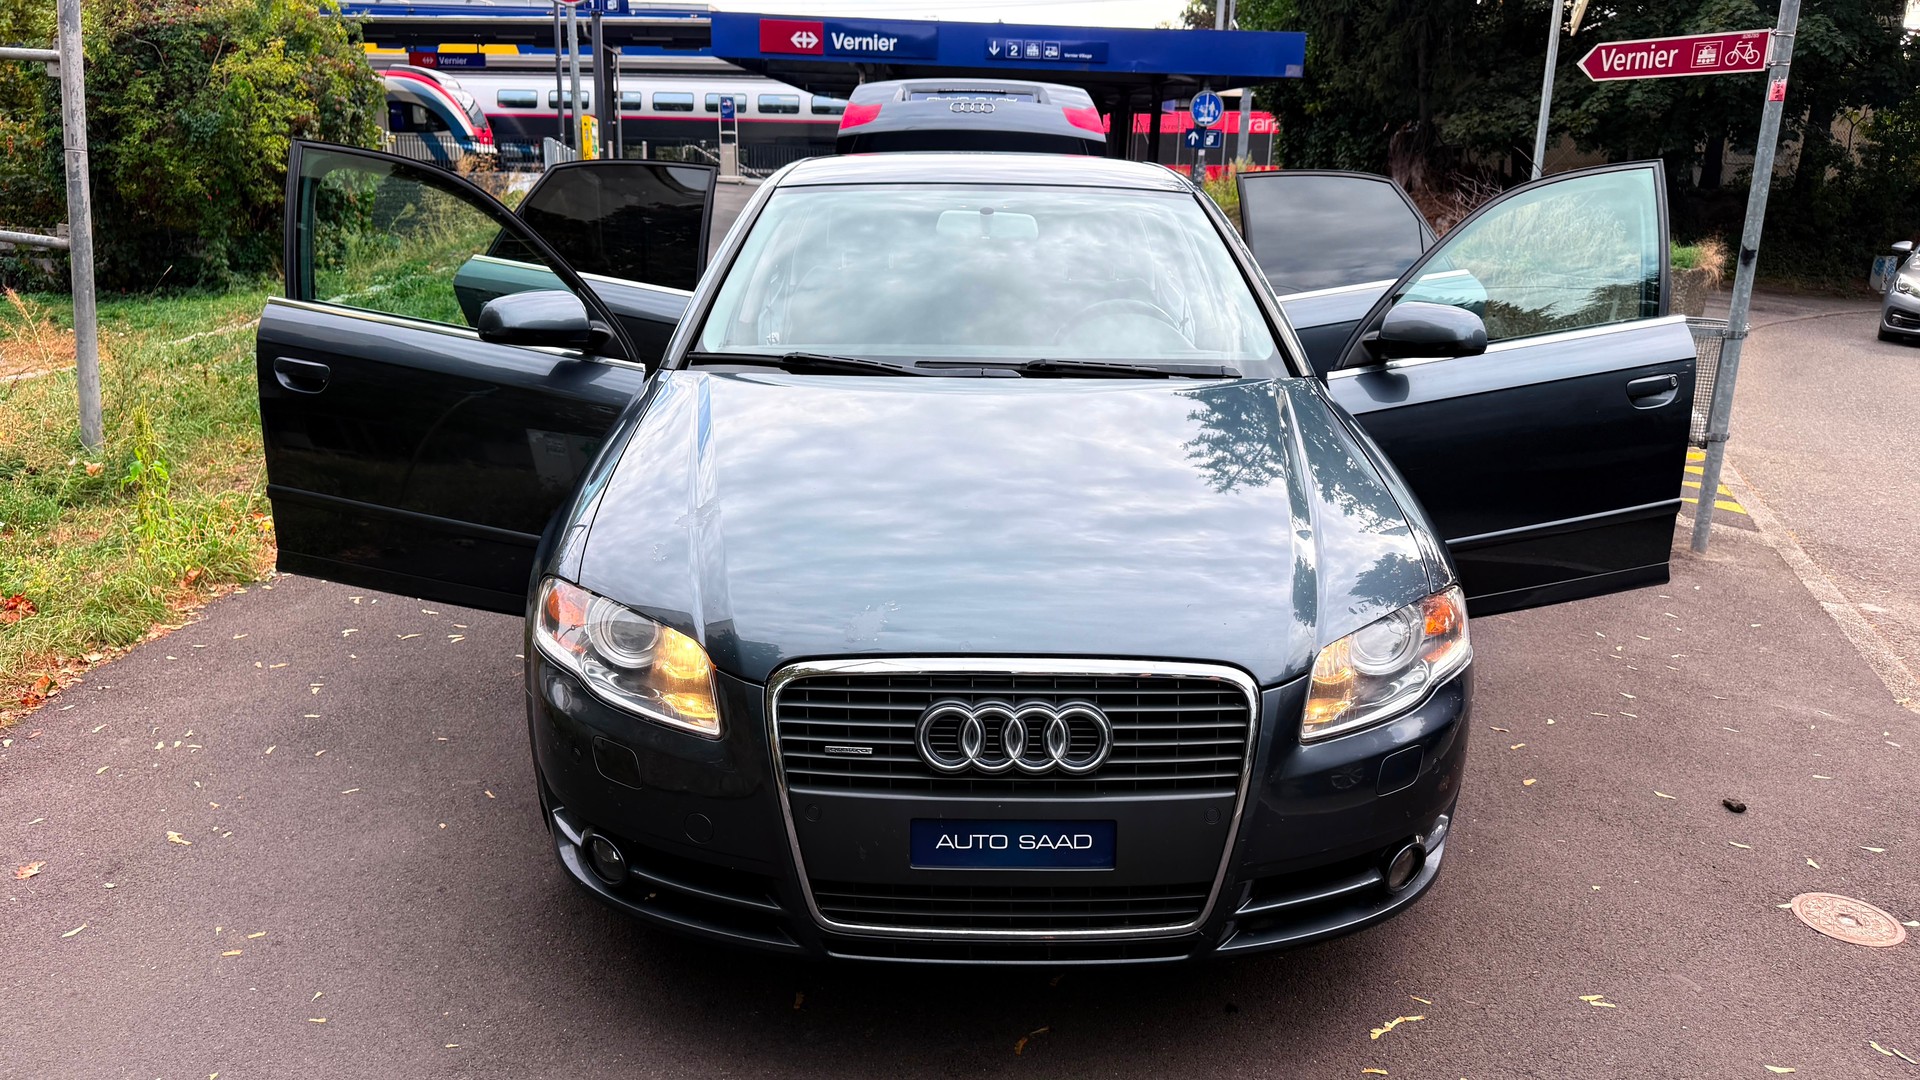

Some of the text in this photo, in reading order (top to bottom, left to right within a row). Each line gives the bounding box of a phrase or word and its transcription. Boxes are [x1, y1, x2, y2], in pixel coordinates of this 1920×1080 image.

[831, 32, 898, 52] Vernier
[1010, 44, 1018, 56] 2
[438, 56, 468, 65] Vernier
[1601, 44, 1679, 72] Vernier
[936, 834, 1093, 850] AUTO SAAD
